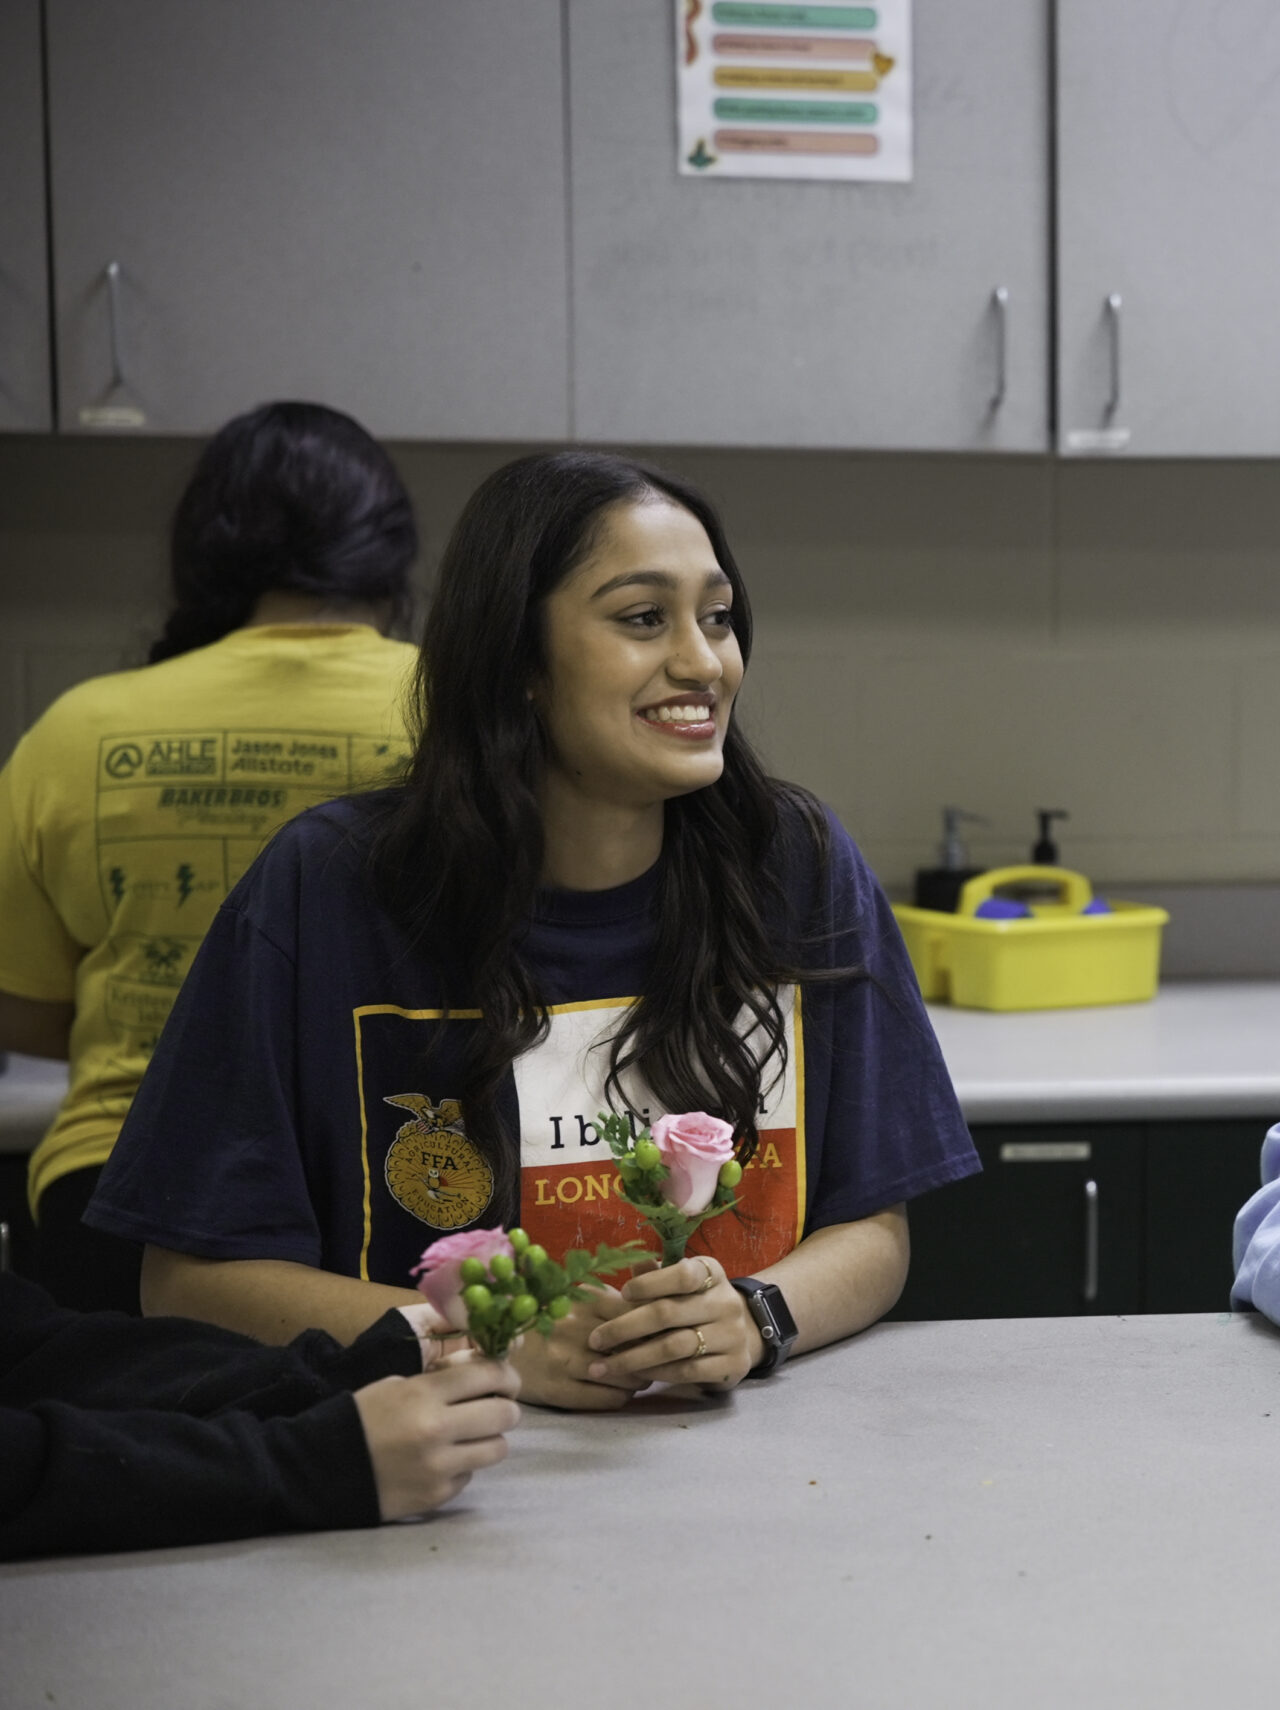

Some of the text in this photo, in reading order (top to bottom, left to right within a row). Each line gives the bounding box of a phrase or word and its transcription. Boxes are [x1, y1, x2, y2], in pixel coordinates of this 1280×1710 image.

[231, 757, 315, 776] Allstate
[405, 1141, 475, 1174] AGRICULTURAL
[421, 1151, 458, 1170] FFA
[412, 1188, 470, 1214] EDUCATION
